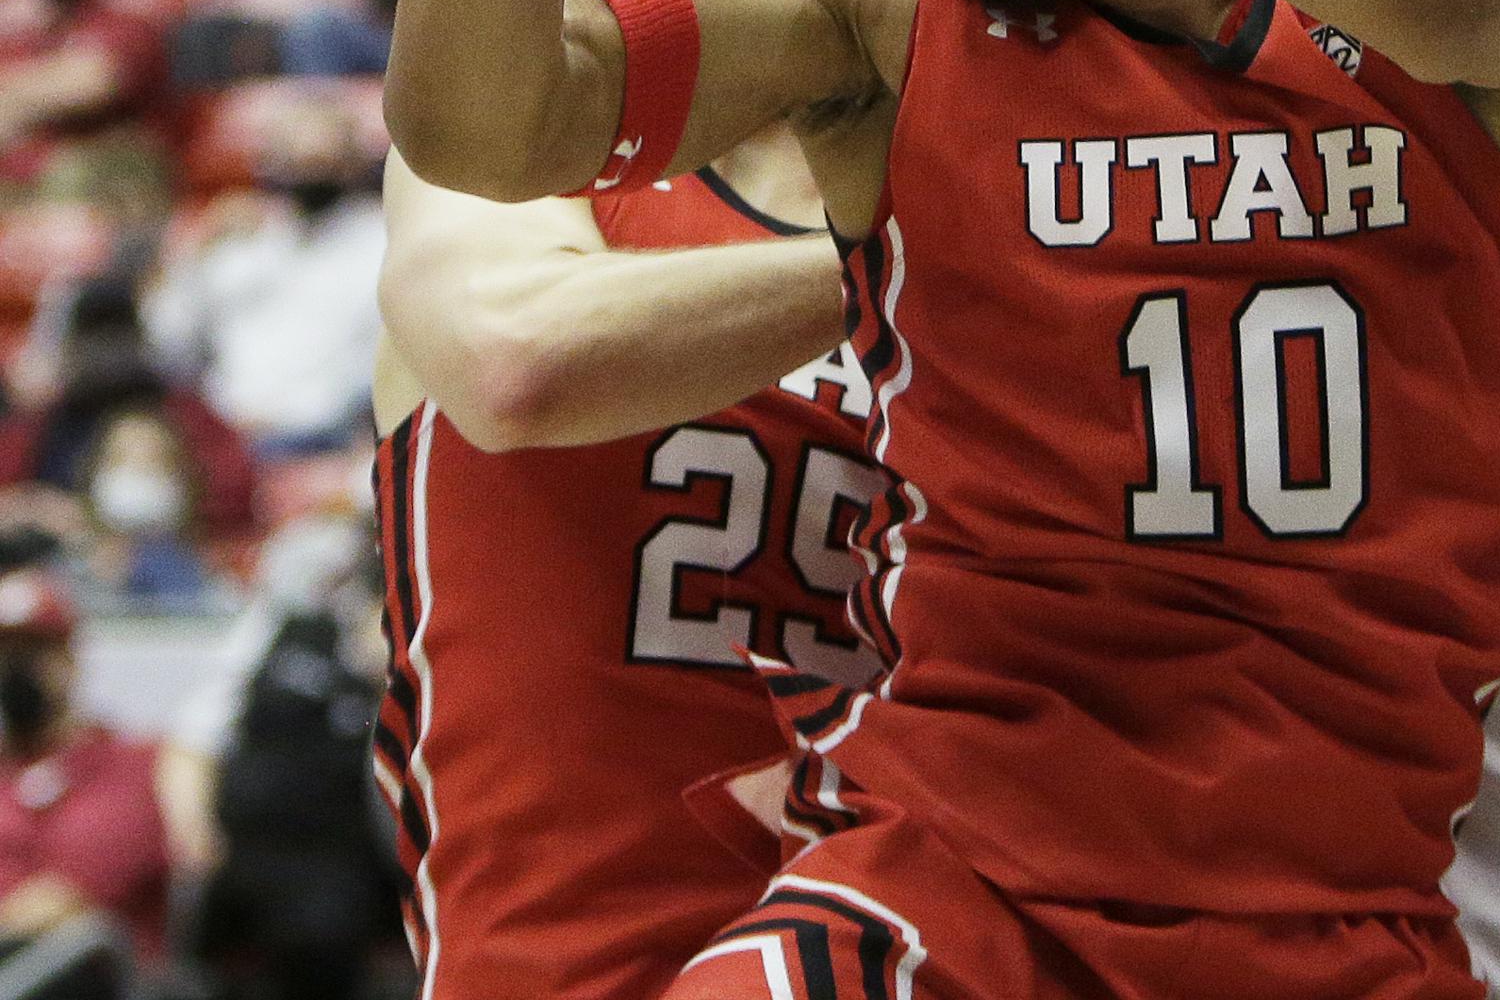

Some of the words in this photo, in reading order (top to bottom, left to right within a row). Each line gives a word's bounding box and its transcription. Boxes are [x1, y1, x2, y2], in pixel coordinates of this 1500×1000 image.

[1018, 123, 1408, 249] UTAH
[1119, 280, 1369, 541] 10
[626, 420, 890, 690] 25
